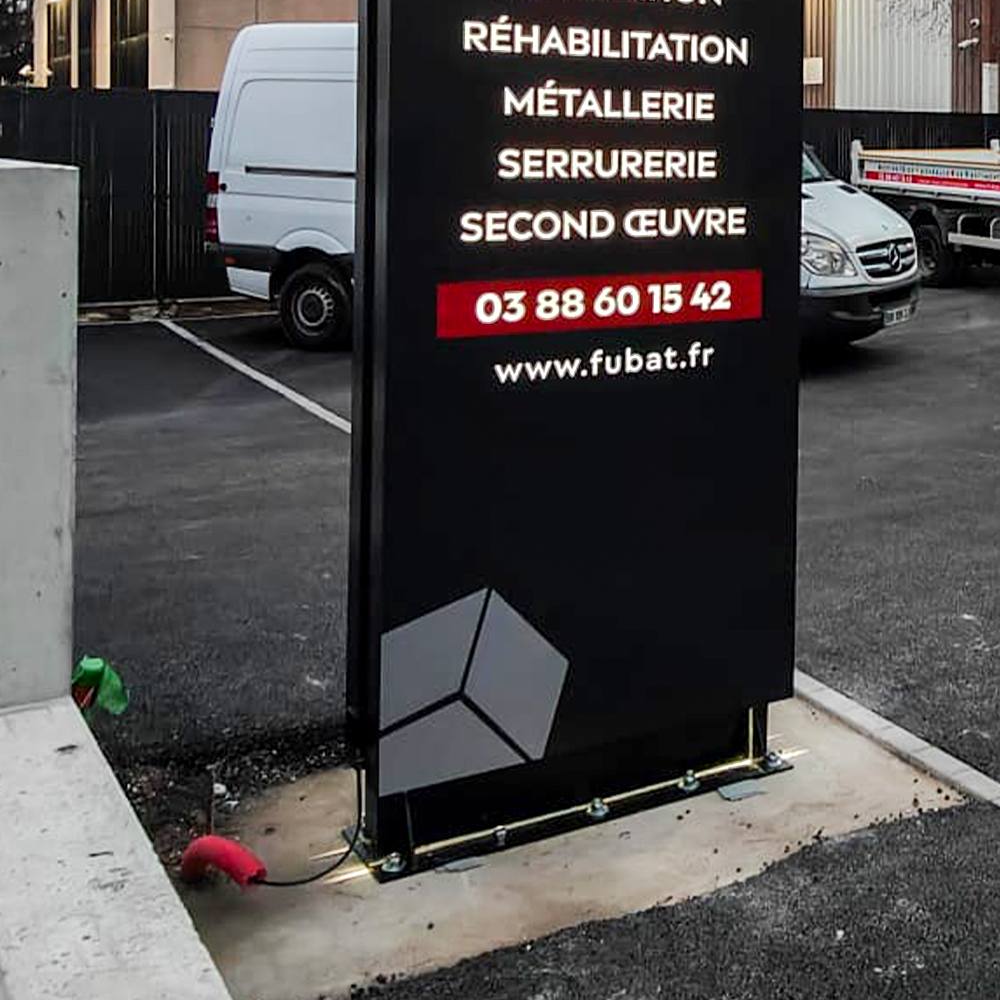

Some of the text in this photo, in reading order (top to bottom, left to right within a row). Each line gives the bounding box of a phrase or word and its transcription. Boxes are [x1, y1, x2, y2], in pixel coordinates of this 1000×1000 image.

[462, 14, 748, 65] RÉHABILITATION
[503, 80, 715, 121] MÉTALLERIE
[498, 148, 717, 180] SERRURERIE
[460, 207, 747, 242] SECOND ŒUVRE
[475, 280, 732, 325] 03 88 60 15 42
[494, 341, 715, 383] www.fubat.fr
